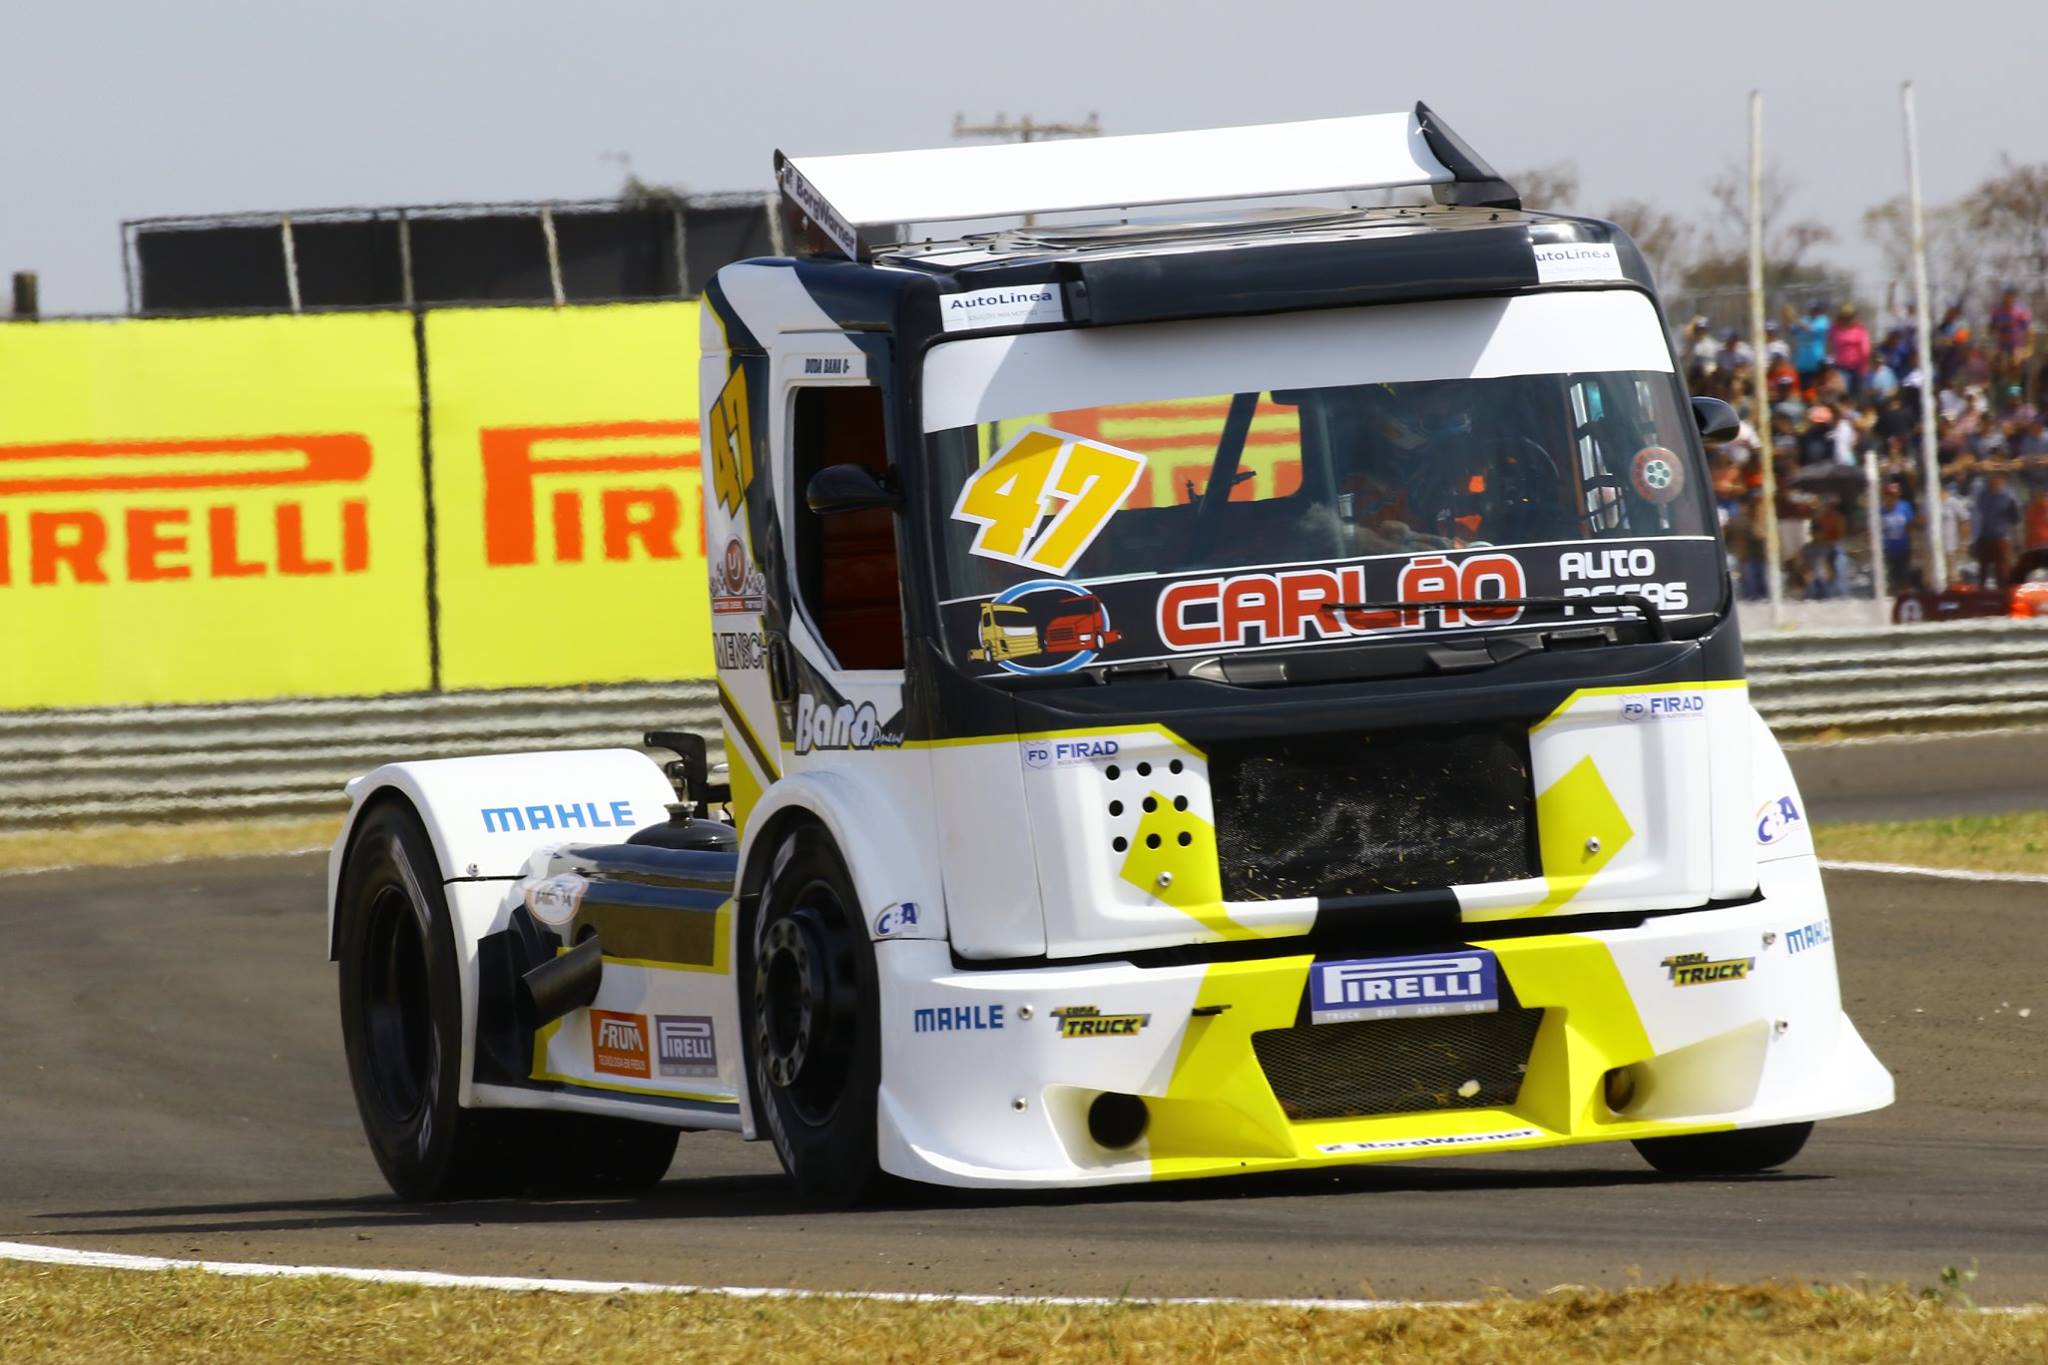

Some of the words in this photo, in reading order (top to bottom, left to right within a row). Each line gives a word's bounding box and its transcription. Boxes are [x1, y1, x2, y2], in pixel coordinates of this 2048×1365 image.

[796, 173, 855, 252] BorgWarner
[1535, 250, 1611, 262] utoLinea
[950, 291, 1053, 310] AutoLinea
[953, 427, 1145, 575] 47
[1559, 548, 1656, 581] AUTO
[1157, 554, 1526, 652] CARLÃO
[1624, 703, 1644, 714] FD
[1651, 696, 1704, 714] FIRAD
[796, 692, 878, 756] Bana
[1028, 750, 1048, 760] FD
[1056, 741, 1119, 759] FIRAD
[481, 801, 637, 833] MAHLE
[1323, 957, 1483, 1004] PIRELLI
[1678, 963, 1746, 985] TRUCK
[914, 1005, 1004, 1032] MAHLE
[1067, 1019, 1138, 1035] TRUCK
[598, 1019, 644, 1053] FRUM
[660, 1022, 712, 1058] PIRELLI
[1357, 1129, 1534, 1149] BorgWarner
